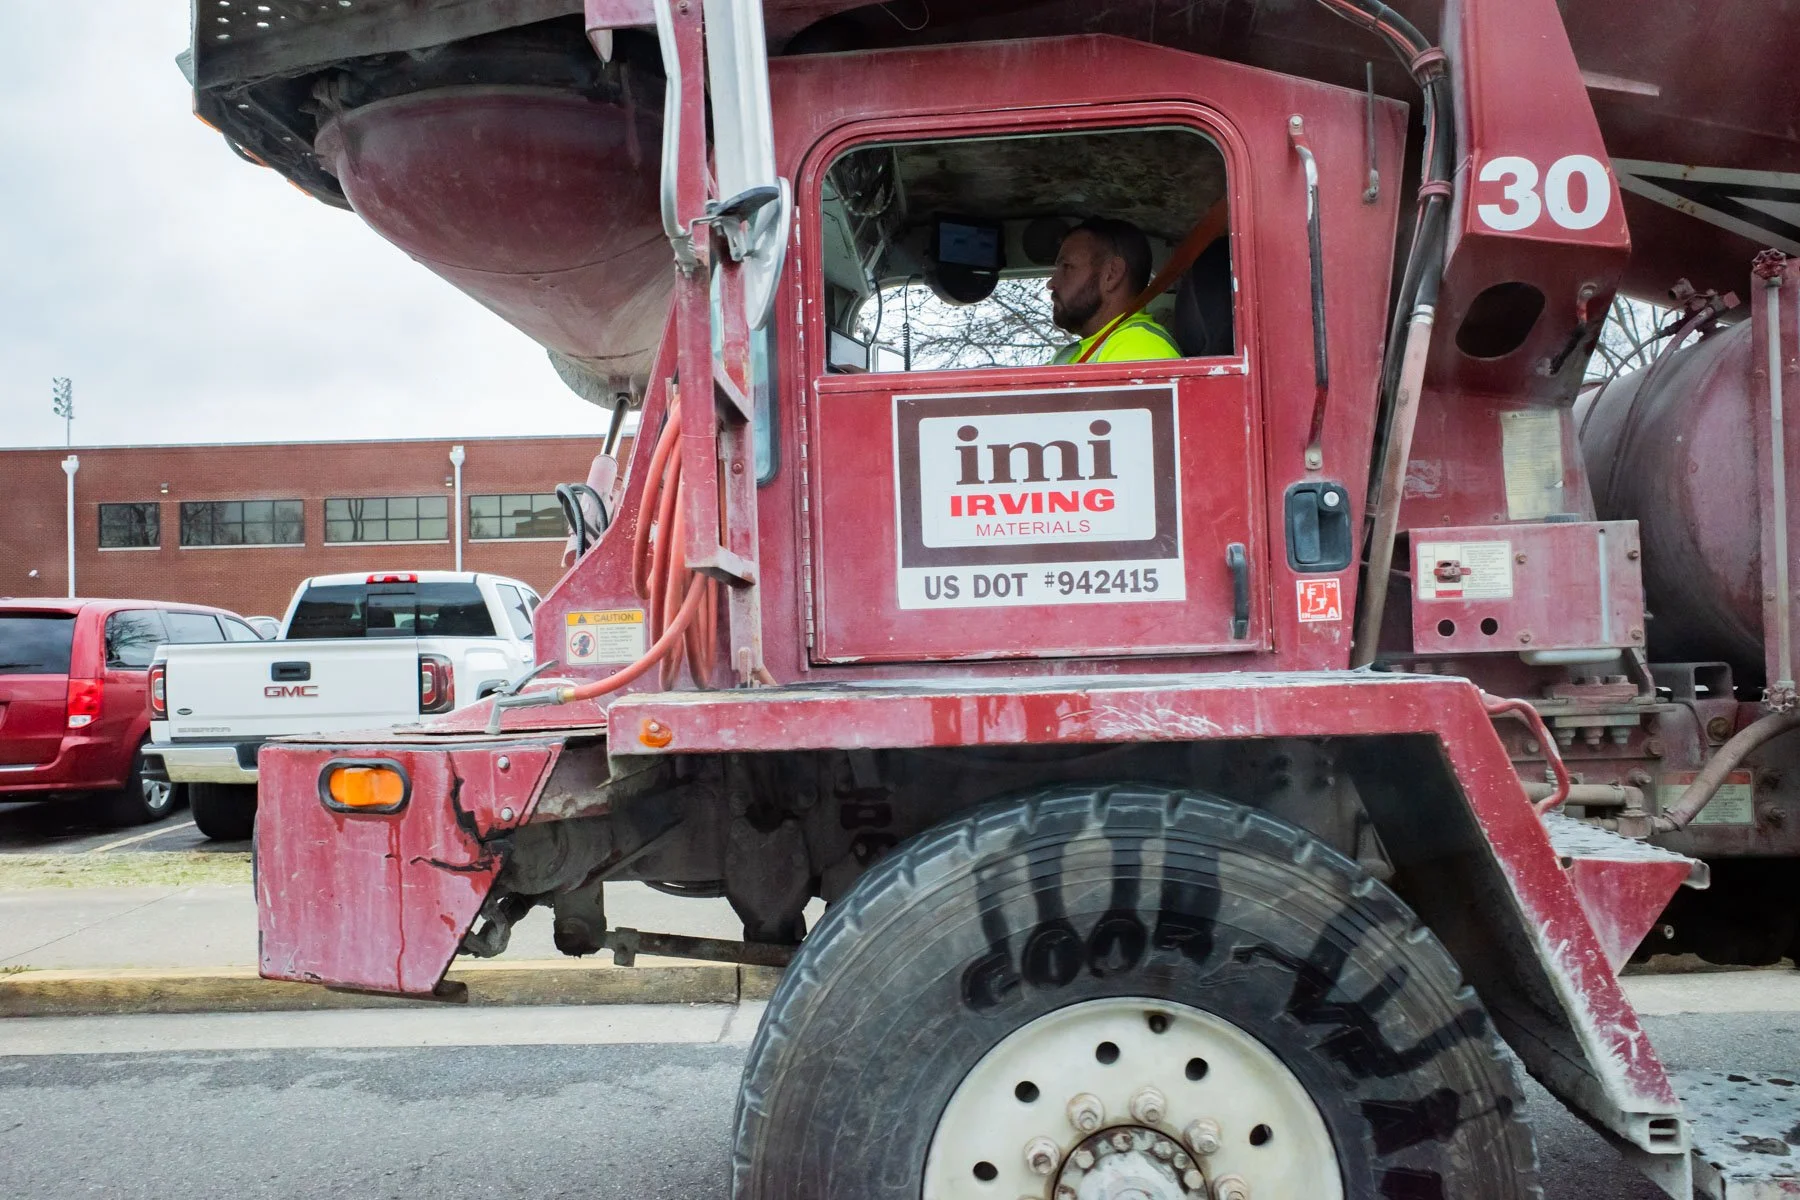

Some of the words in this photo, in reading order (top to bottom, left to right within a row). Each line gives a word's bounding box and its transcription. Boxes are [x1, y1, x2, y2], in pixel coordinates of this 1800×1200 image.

[1477, 154, 1611, 231] 30
[955, 419, 1118, 486] imi
[950, 488, 1115, 517] IRVING
[976, 519, 1091, 537] MATERIALS
[924, 575, 960, 601] US
[973, 572, 1028, 599] DOT
[1044, 568, 1159, 596] #942415
[593, 613, 634, 622] CAUTION
[264, 685, 318, 698] GMC
